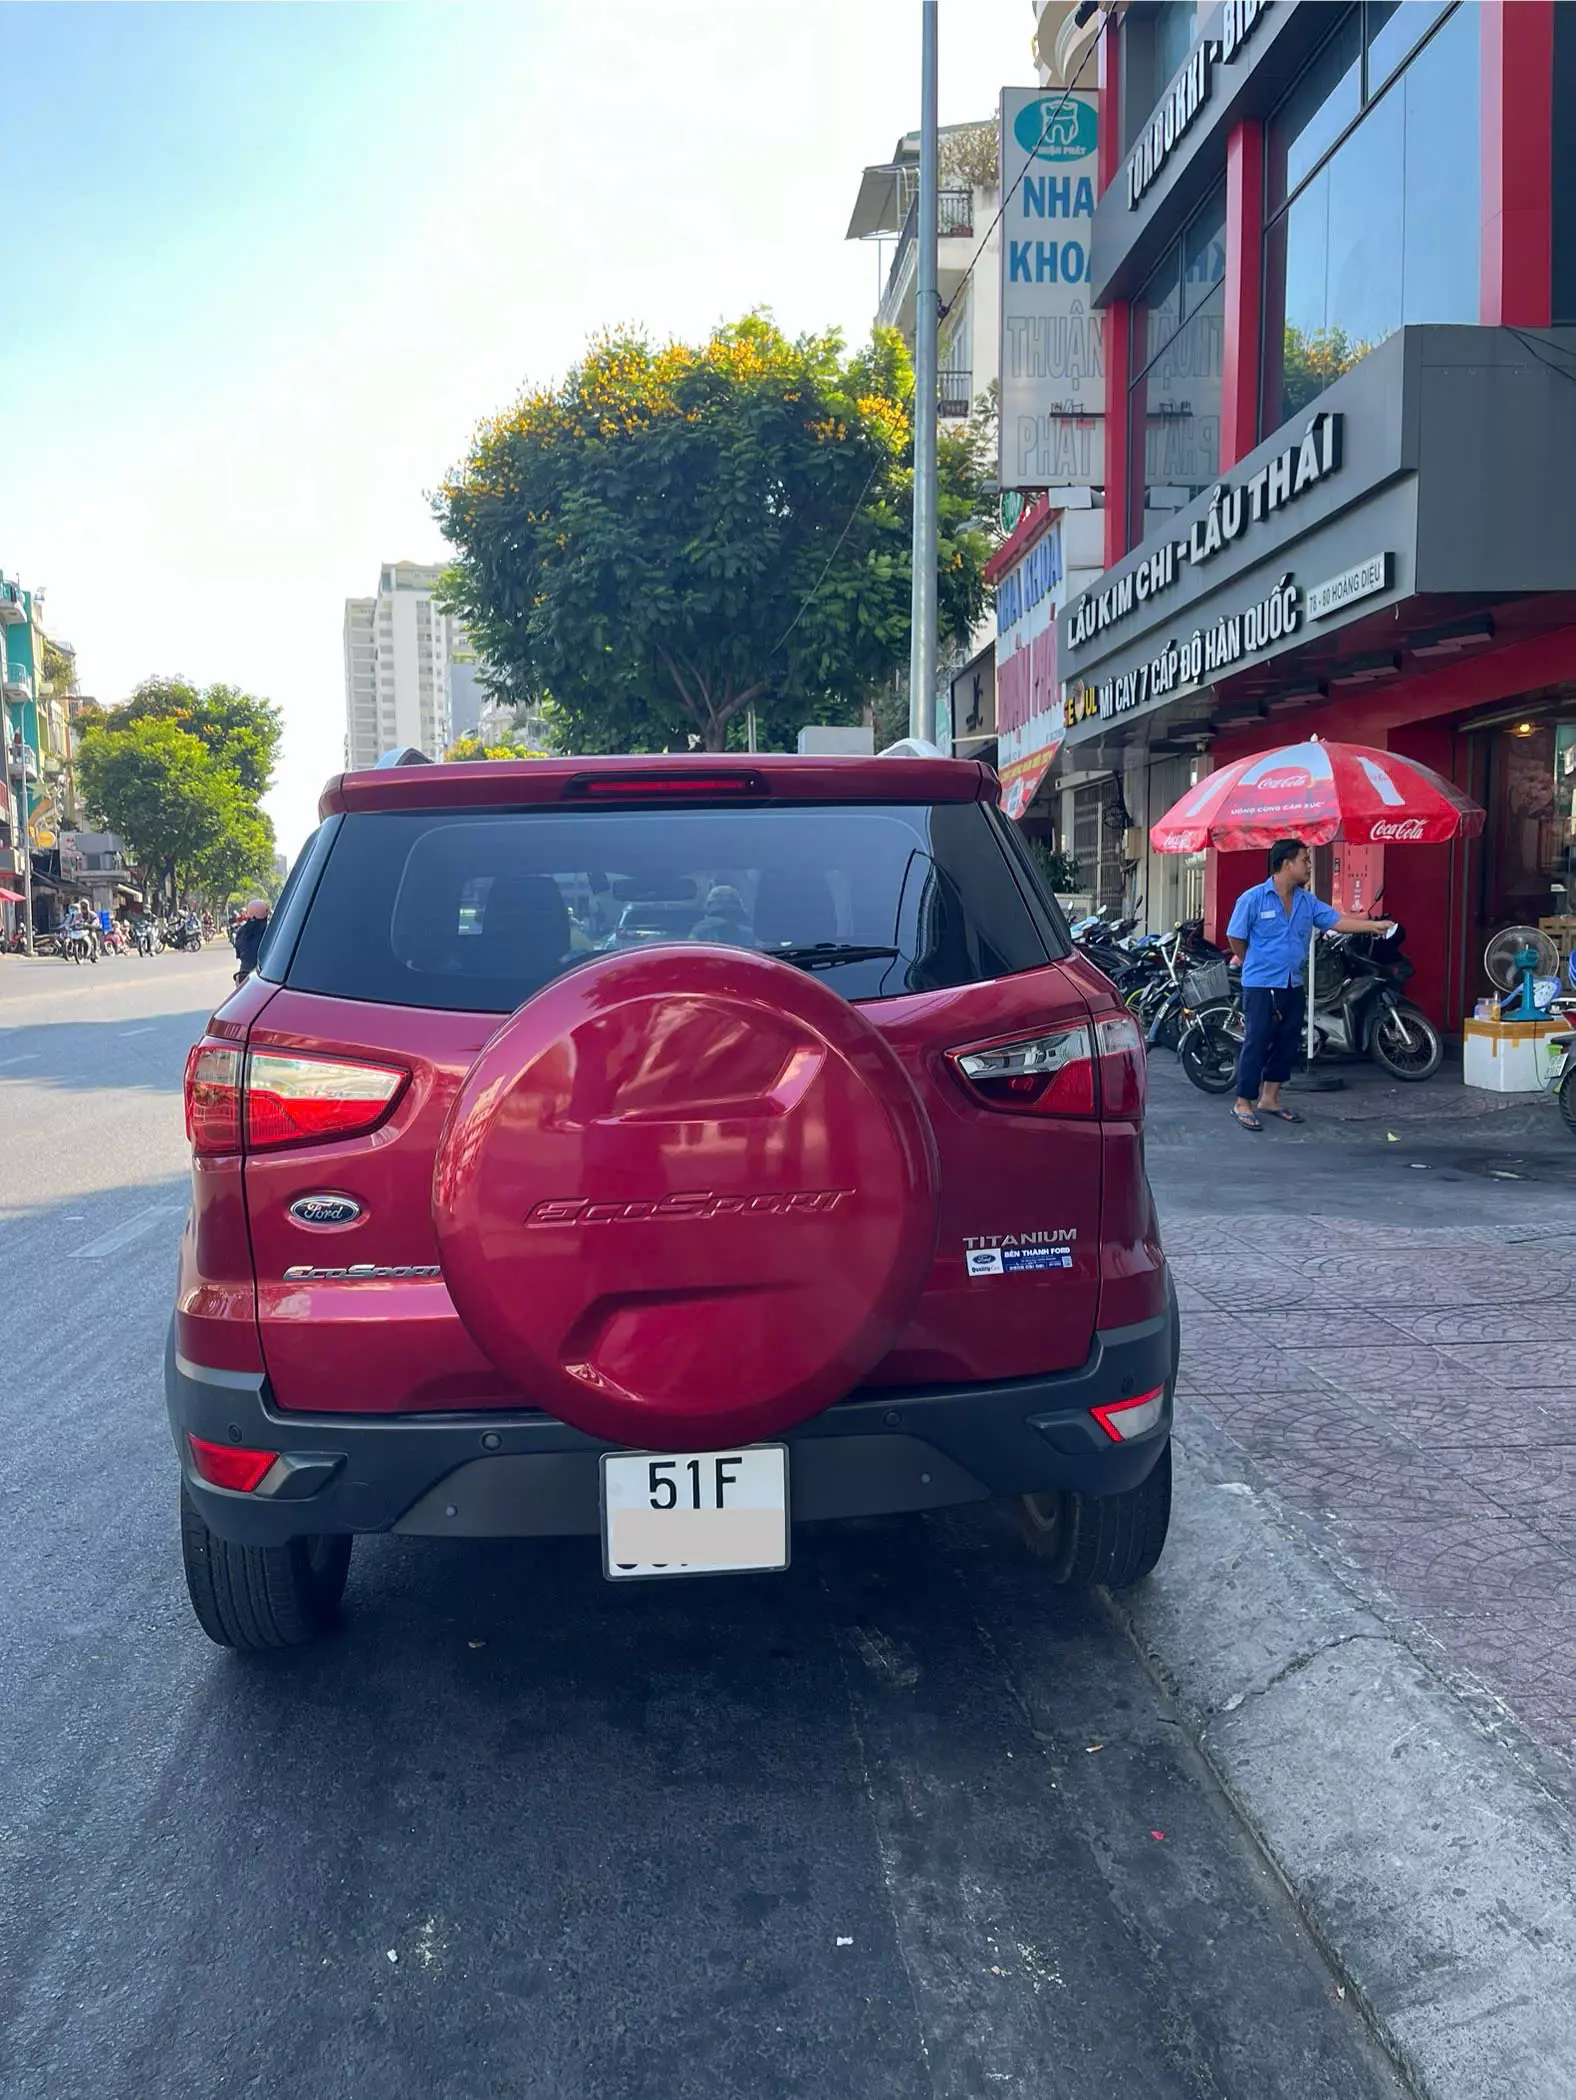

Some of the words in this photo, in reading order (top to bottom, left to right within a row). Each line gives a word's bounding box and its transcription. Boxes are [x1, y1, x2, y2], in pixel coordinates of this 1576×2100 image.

[1023, 176, 1095, 218] NHA
[1010, 240, 1091, 284] KHO
[1068, 594, 1097, 650] LẨU
[1099, 571, 1134, 629] KIM
[1136, 541, 1173, 601] CHI
[1191, 485, 1241, 565] LẨU
[1248, 413, 1335, 522] THÁI
[1100, 678, 1114, 720] MÌ
[1115, 670, 1138, 712] CAY
[1140, 664, 1149, 701] 7
[1151, 641, 1178, 695] CẤP
[1180, 630, 1202, 684] ĐỘ
[1205, 616, 1240, 671] HÀN
[1244, 575, 1297, 651] QUỐC
[304, 1201, 343, 1220] Ford
[962, 1228, 1077, 1249] TITANIUM
[1050, 1246, 1071, 1255] FORD
